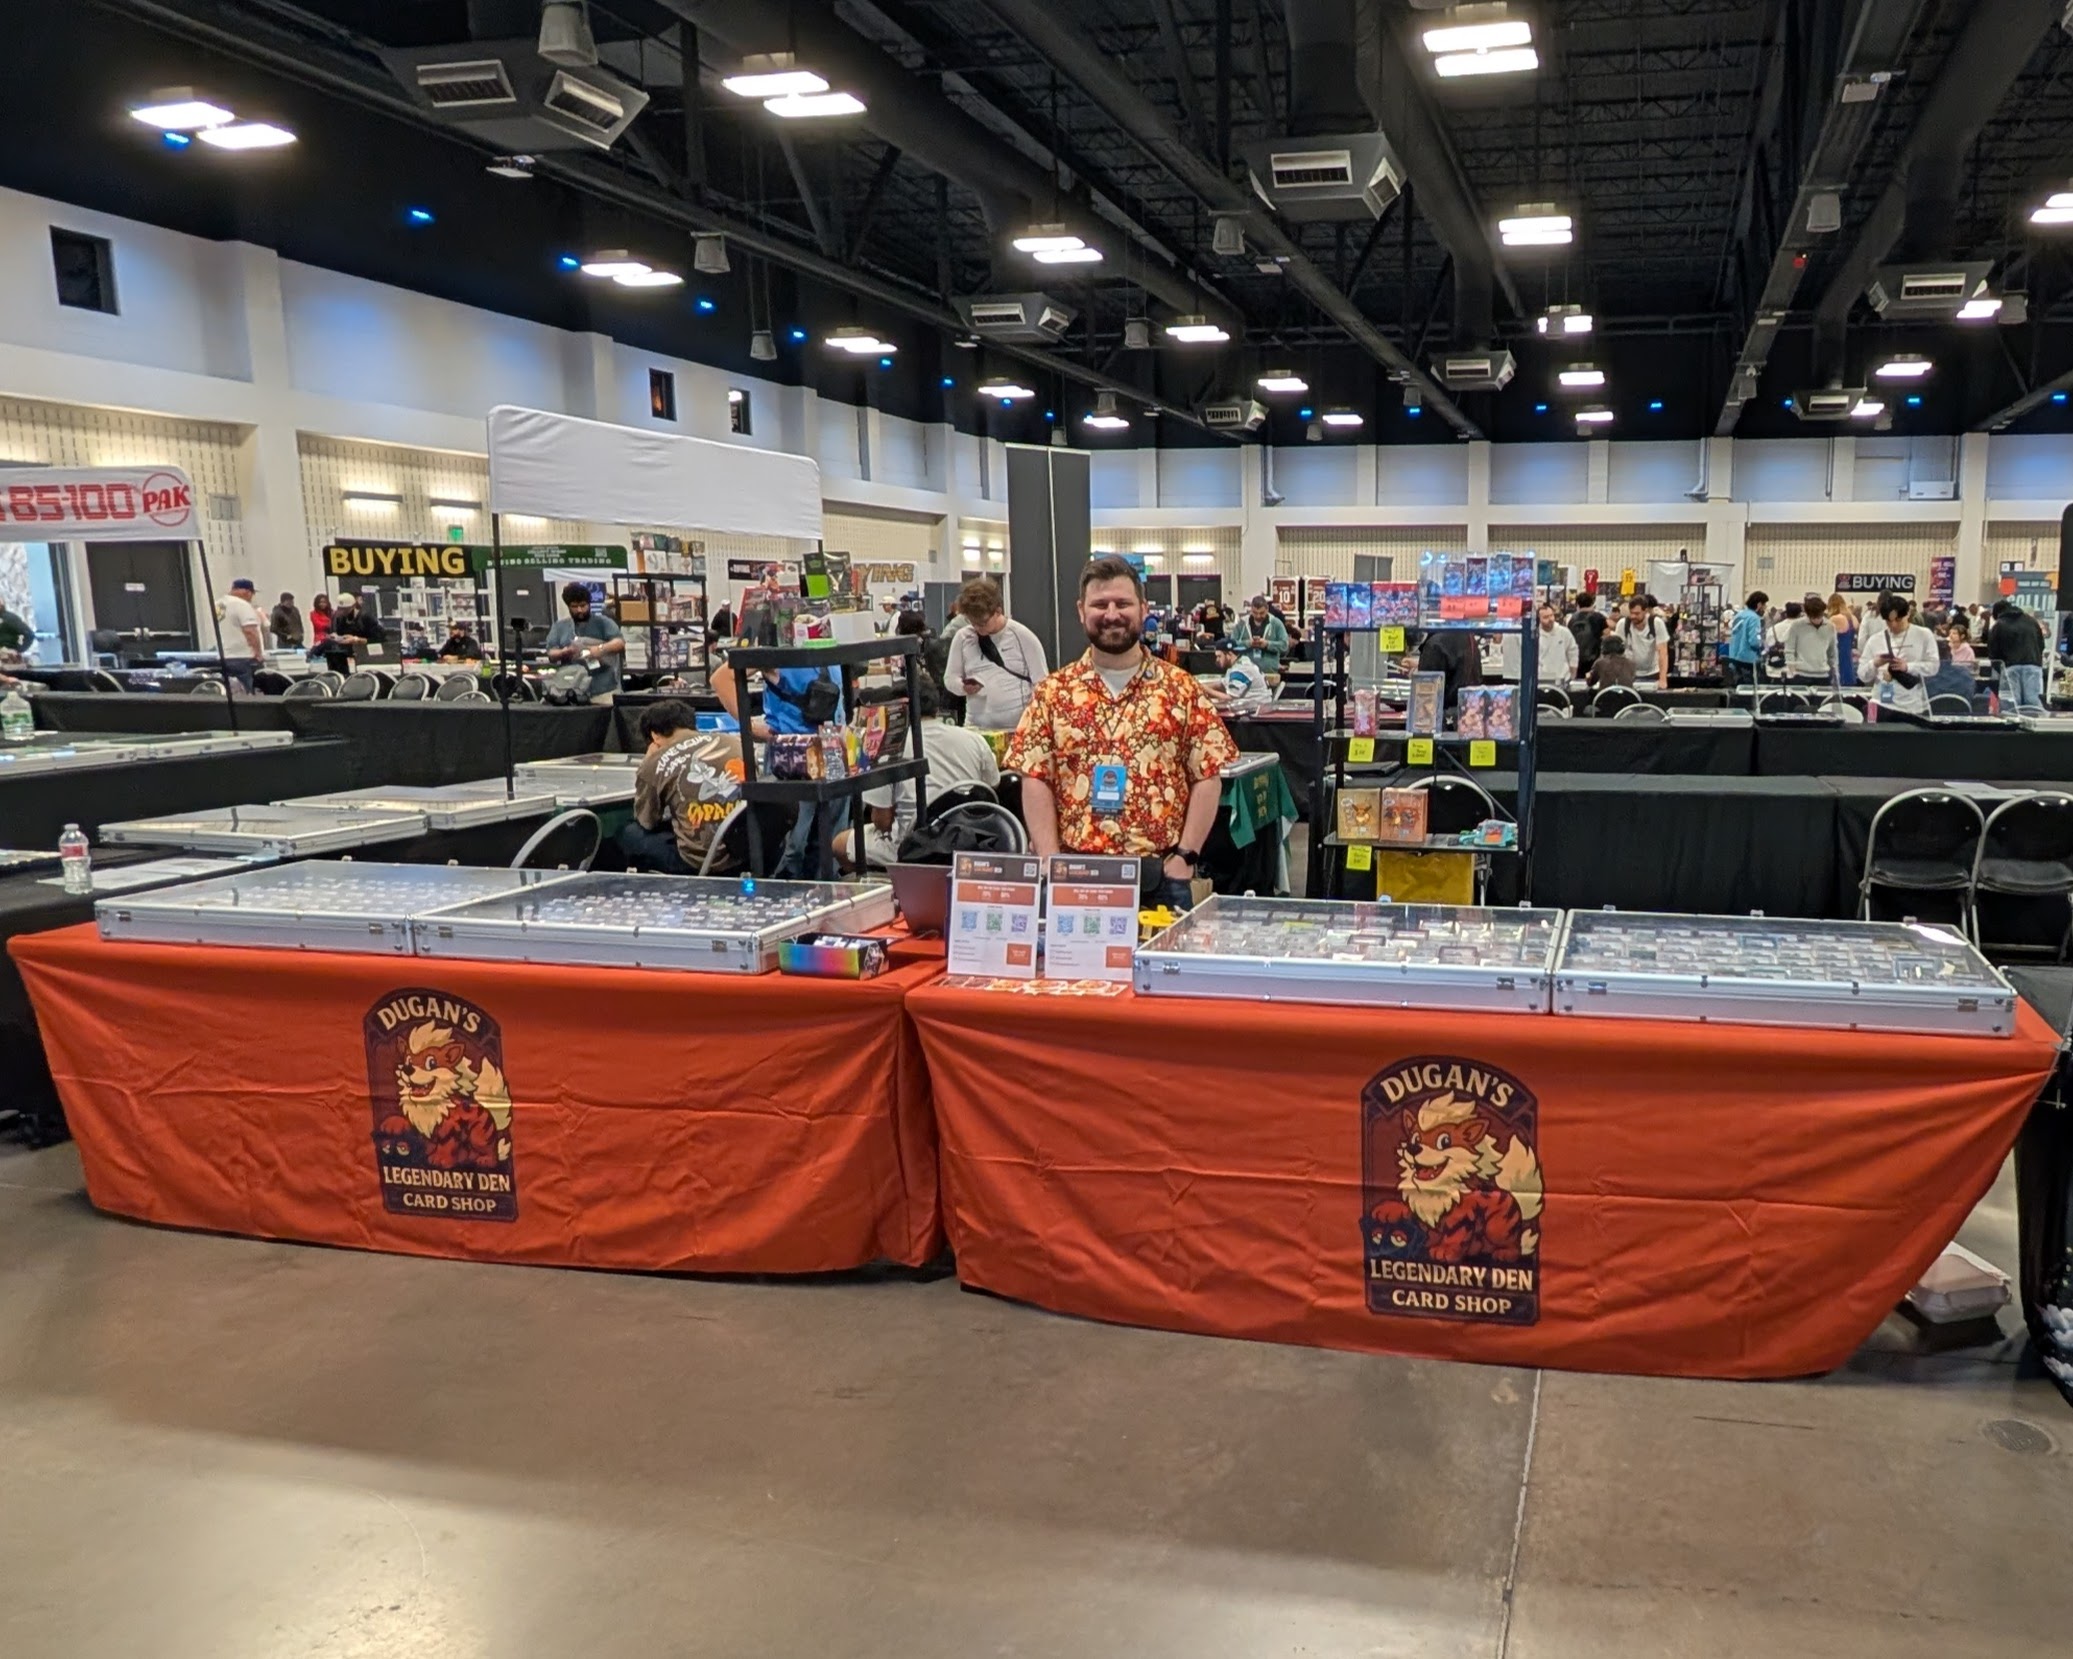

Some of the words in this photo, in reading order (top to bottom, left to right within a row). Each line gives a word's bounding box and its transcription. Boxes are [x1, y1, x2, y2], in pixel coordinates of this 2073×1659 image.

[8, 484, 136, 521] 85-100
[143, 484, 191, 513] PAK
[329, 547, 465, 575] BUYING
[568, 557, 612, 565] TRADING
[1852, 576, 1914, 589] BUYING
[1279, 591, 1290, 603] 10
[377, 996, 481, 1034] DUGAN'S
[1380, 1063, 1515, 1108] DUGAN'S
[383, 1166, 474, 1191] LEGENDARY
[478, 1172, 511, 1192] DEN
[403, 1193, 448, 1209] CARD
[451, 1197, 497, 1213] SHOP
[1370, 1258, 1487, 1288] LEGENDARY
[1491, 1267, 1533, 1291] DEN
[1392, 1289, 1449, 1310] CARD
[1455, 1295, 1512, 1315] SHOP
